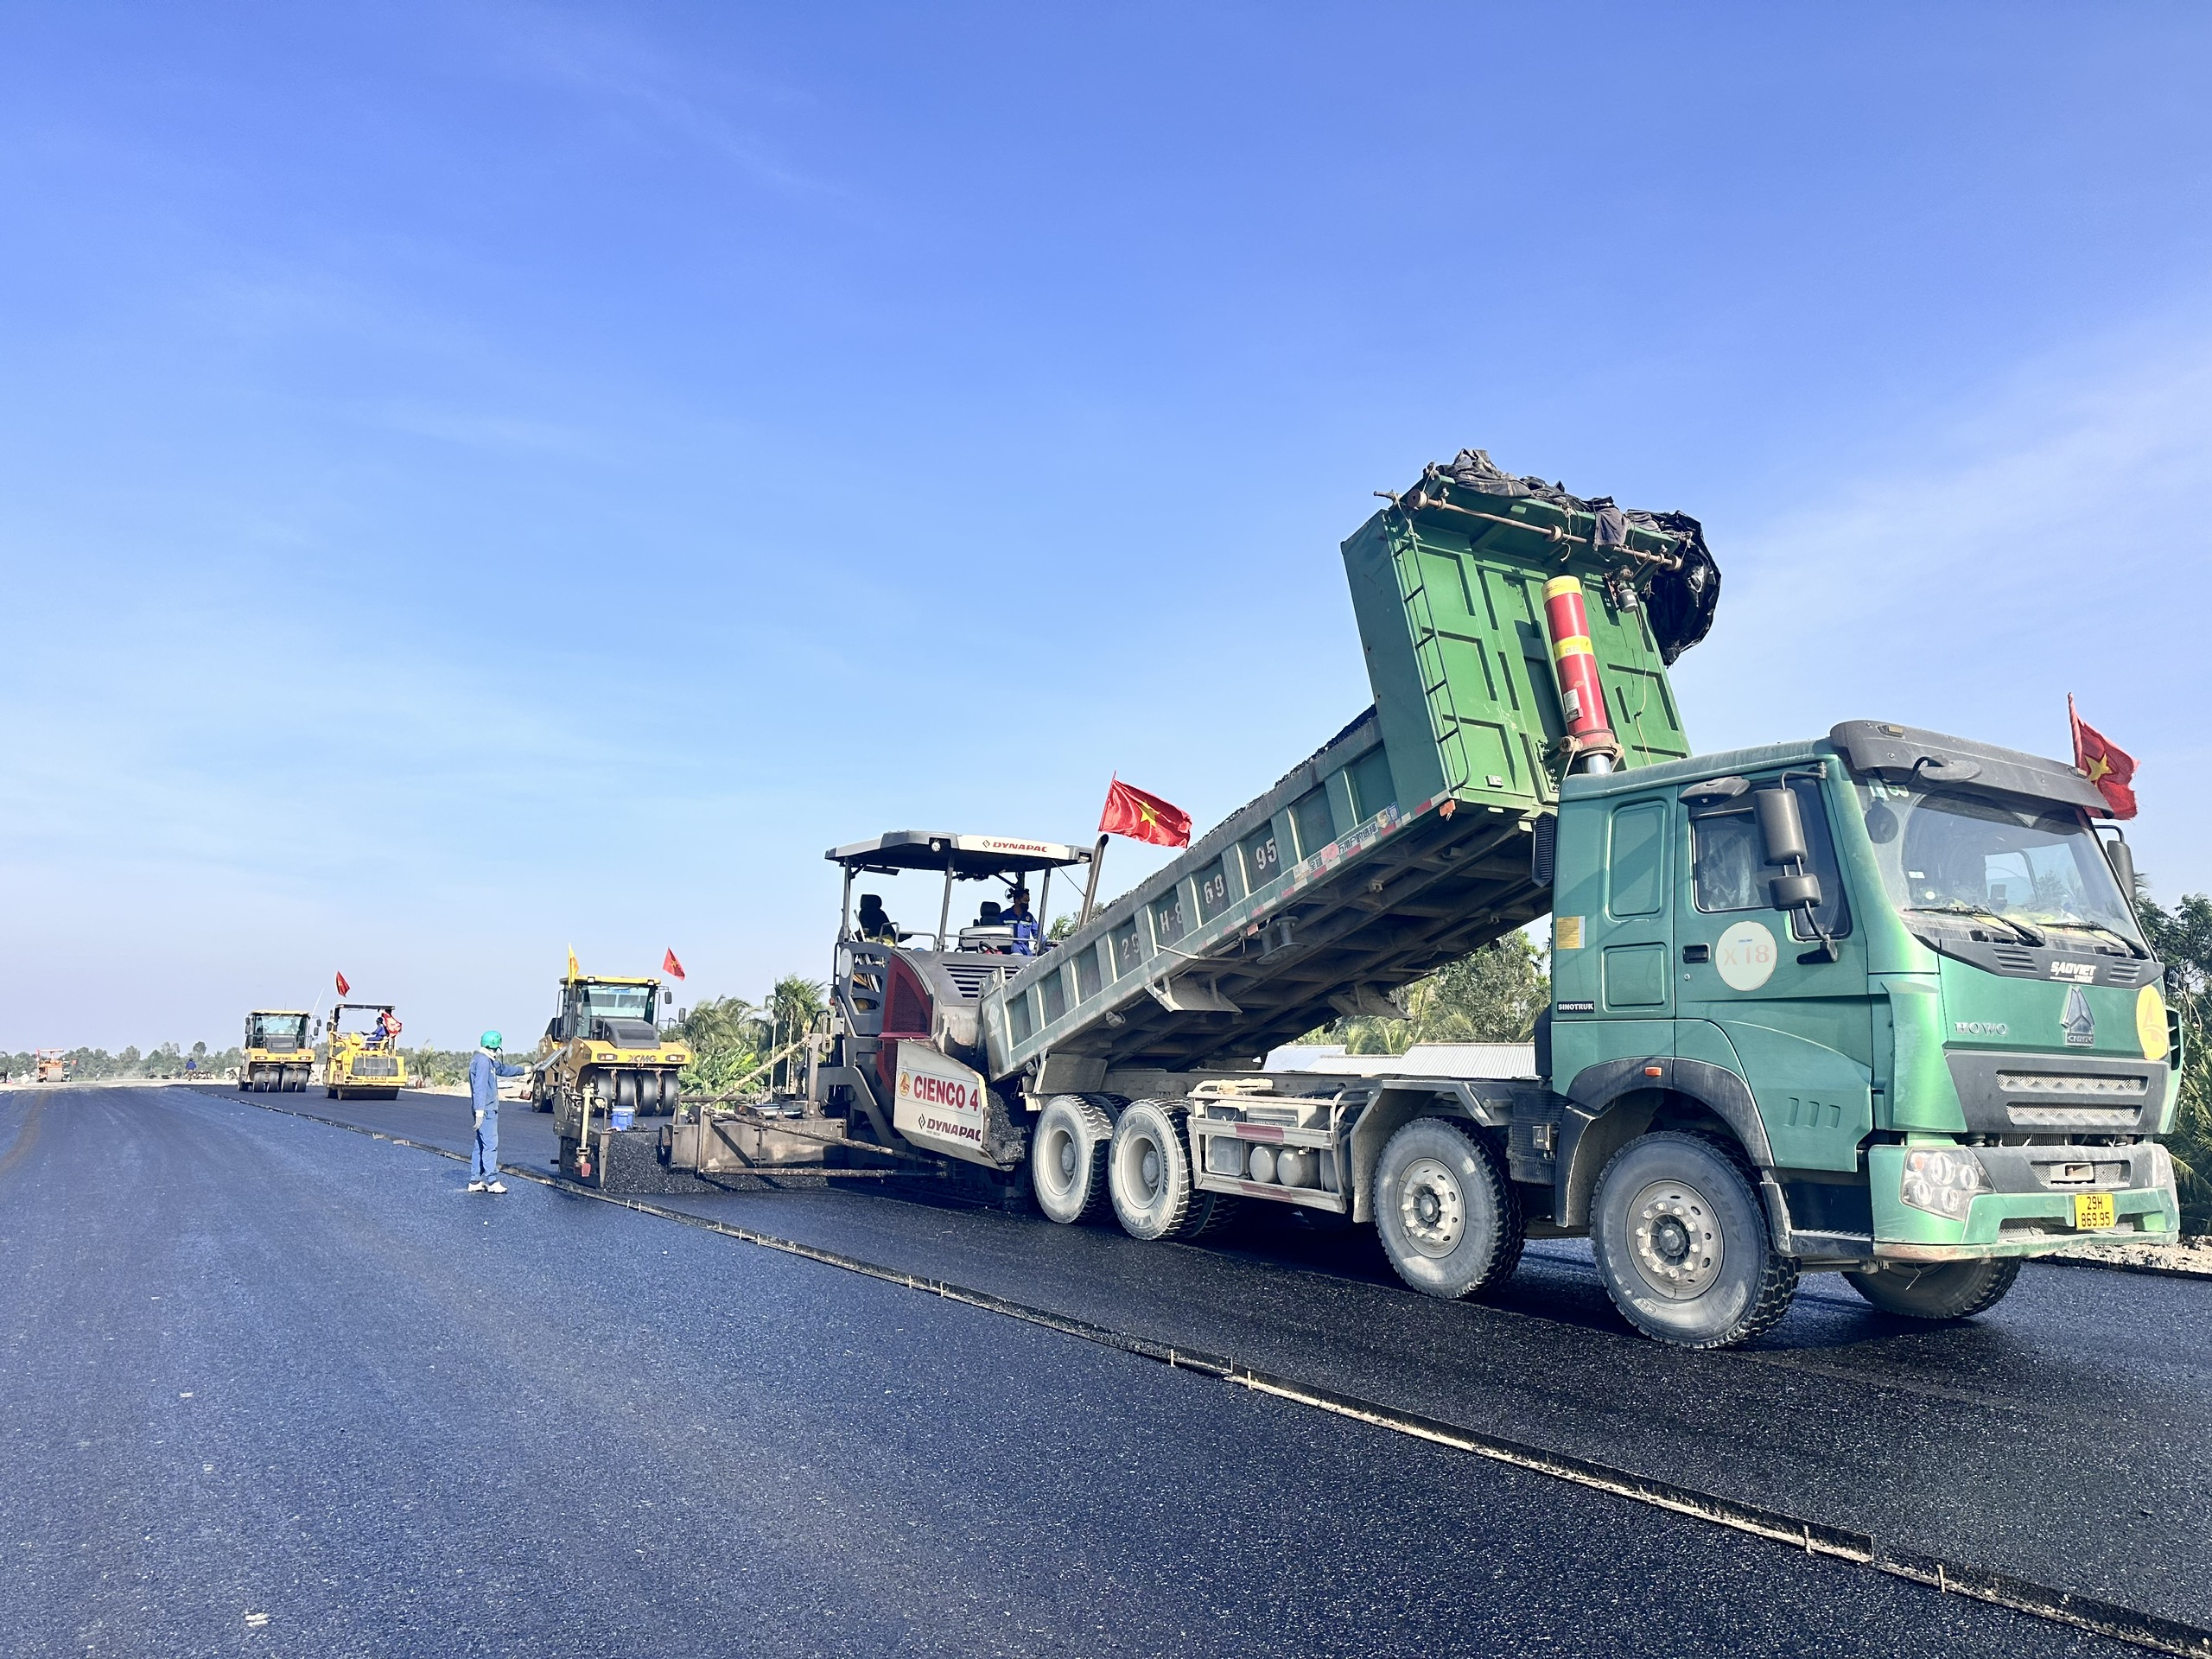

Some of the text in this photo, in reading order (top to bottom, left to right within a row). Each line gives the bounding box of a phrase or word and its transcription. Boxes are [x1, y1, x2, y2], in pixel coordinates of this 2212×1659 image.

[992, 842, 1048, 853] DYNAPAC
[1204, 873, 1224, 905] 69
[1255, 836, 1277, 871] 95
[1954, 1021, 2007, 1036] HOWO
[627, 1054, 658, 1063] XCMG
[913, 1075, 978, 1112] CIENCO 4
[926, 1118, 982, 1142] DYNAPAC
[2087, 1196, 2103, 1210] 29H
[2081, 1212, 2111, 1227] 869.95
